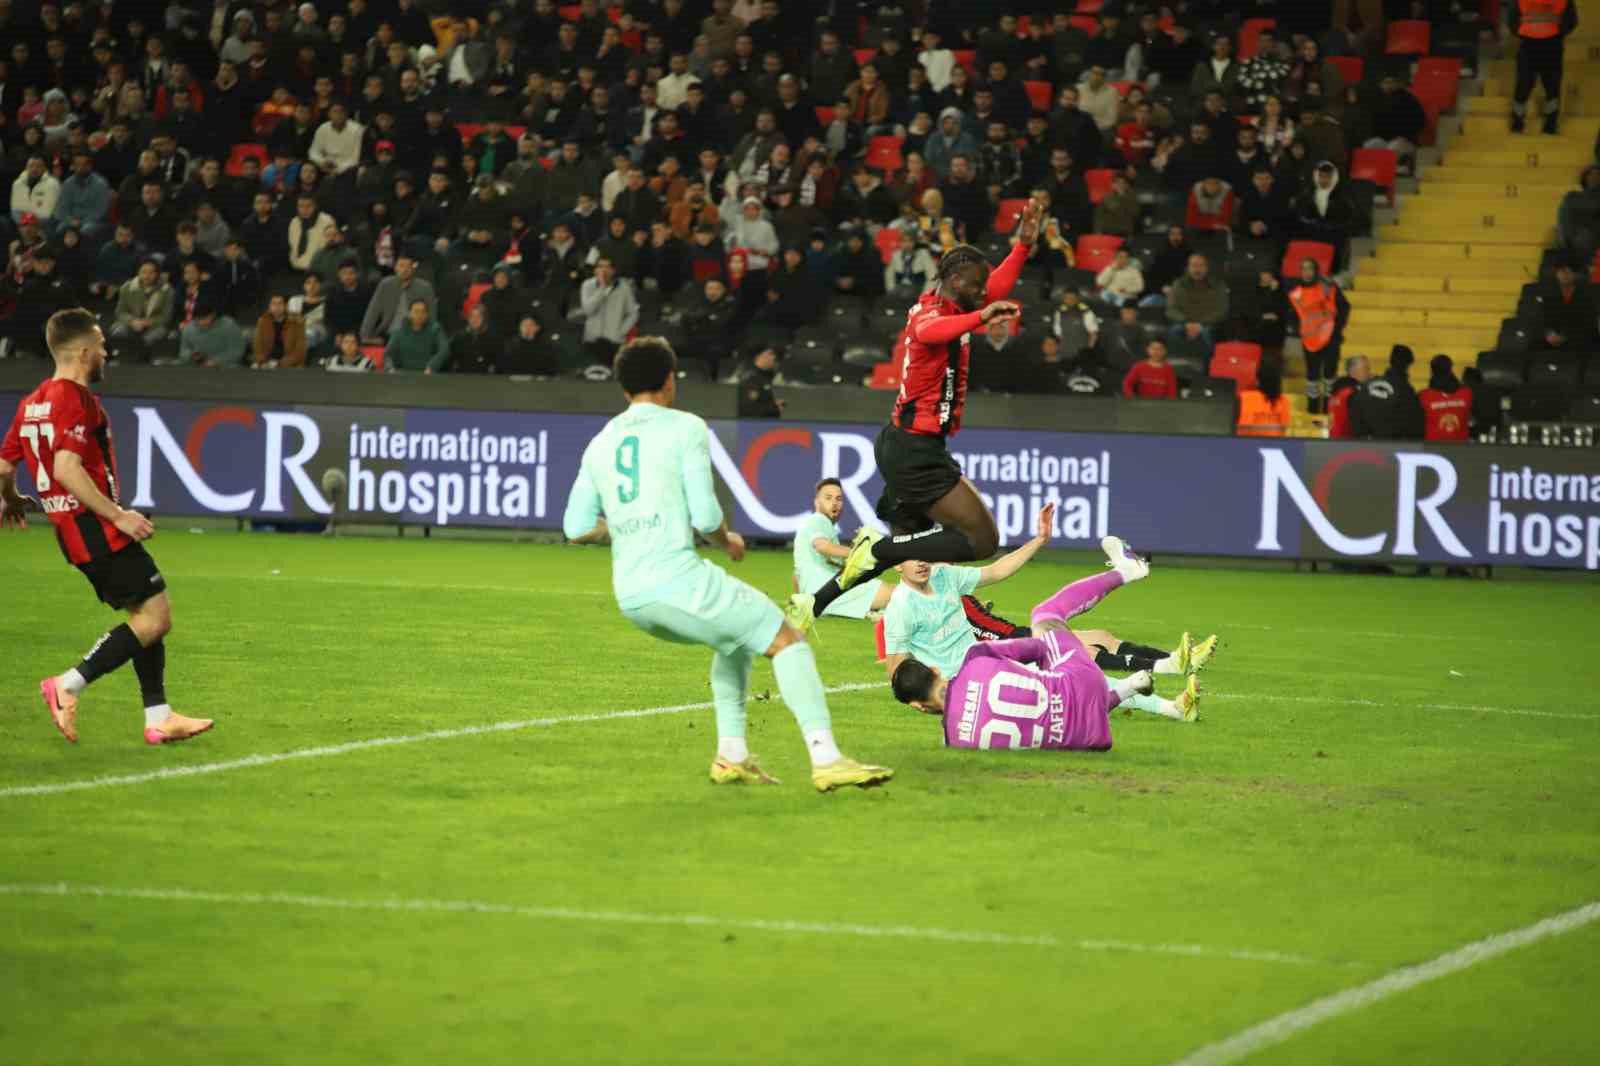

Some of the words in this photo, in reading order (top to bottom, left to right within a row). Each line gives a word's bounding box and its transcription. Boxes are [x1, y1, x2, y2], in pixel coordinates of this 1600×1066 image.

[130, 406, 334, 514] NCR
[350, 423, 548, 465] international
[615, 435, 640, 505] 9
[348, 458, 547, 525] hospital
[980, 483, 1110, 547] pital
[1255, 447, 1473, 558] NCR
[978, 671, 1049, 750] 20
[1048, 692, 1064, 744] ZAFER
